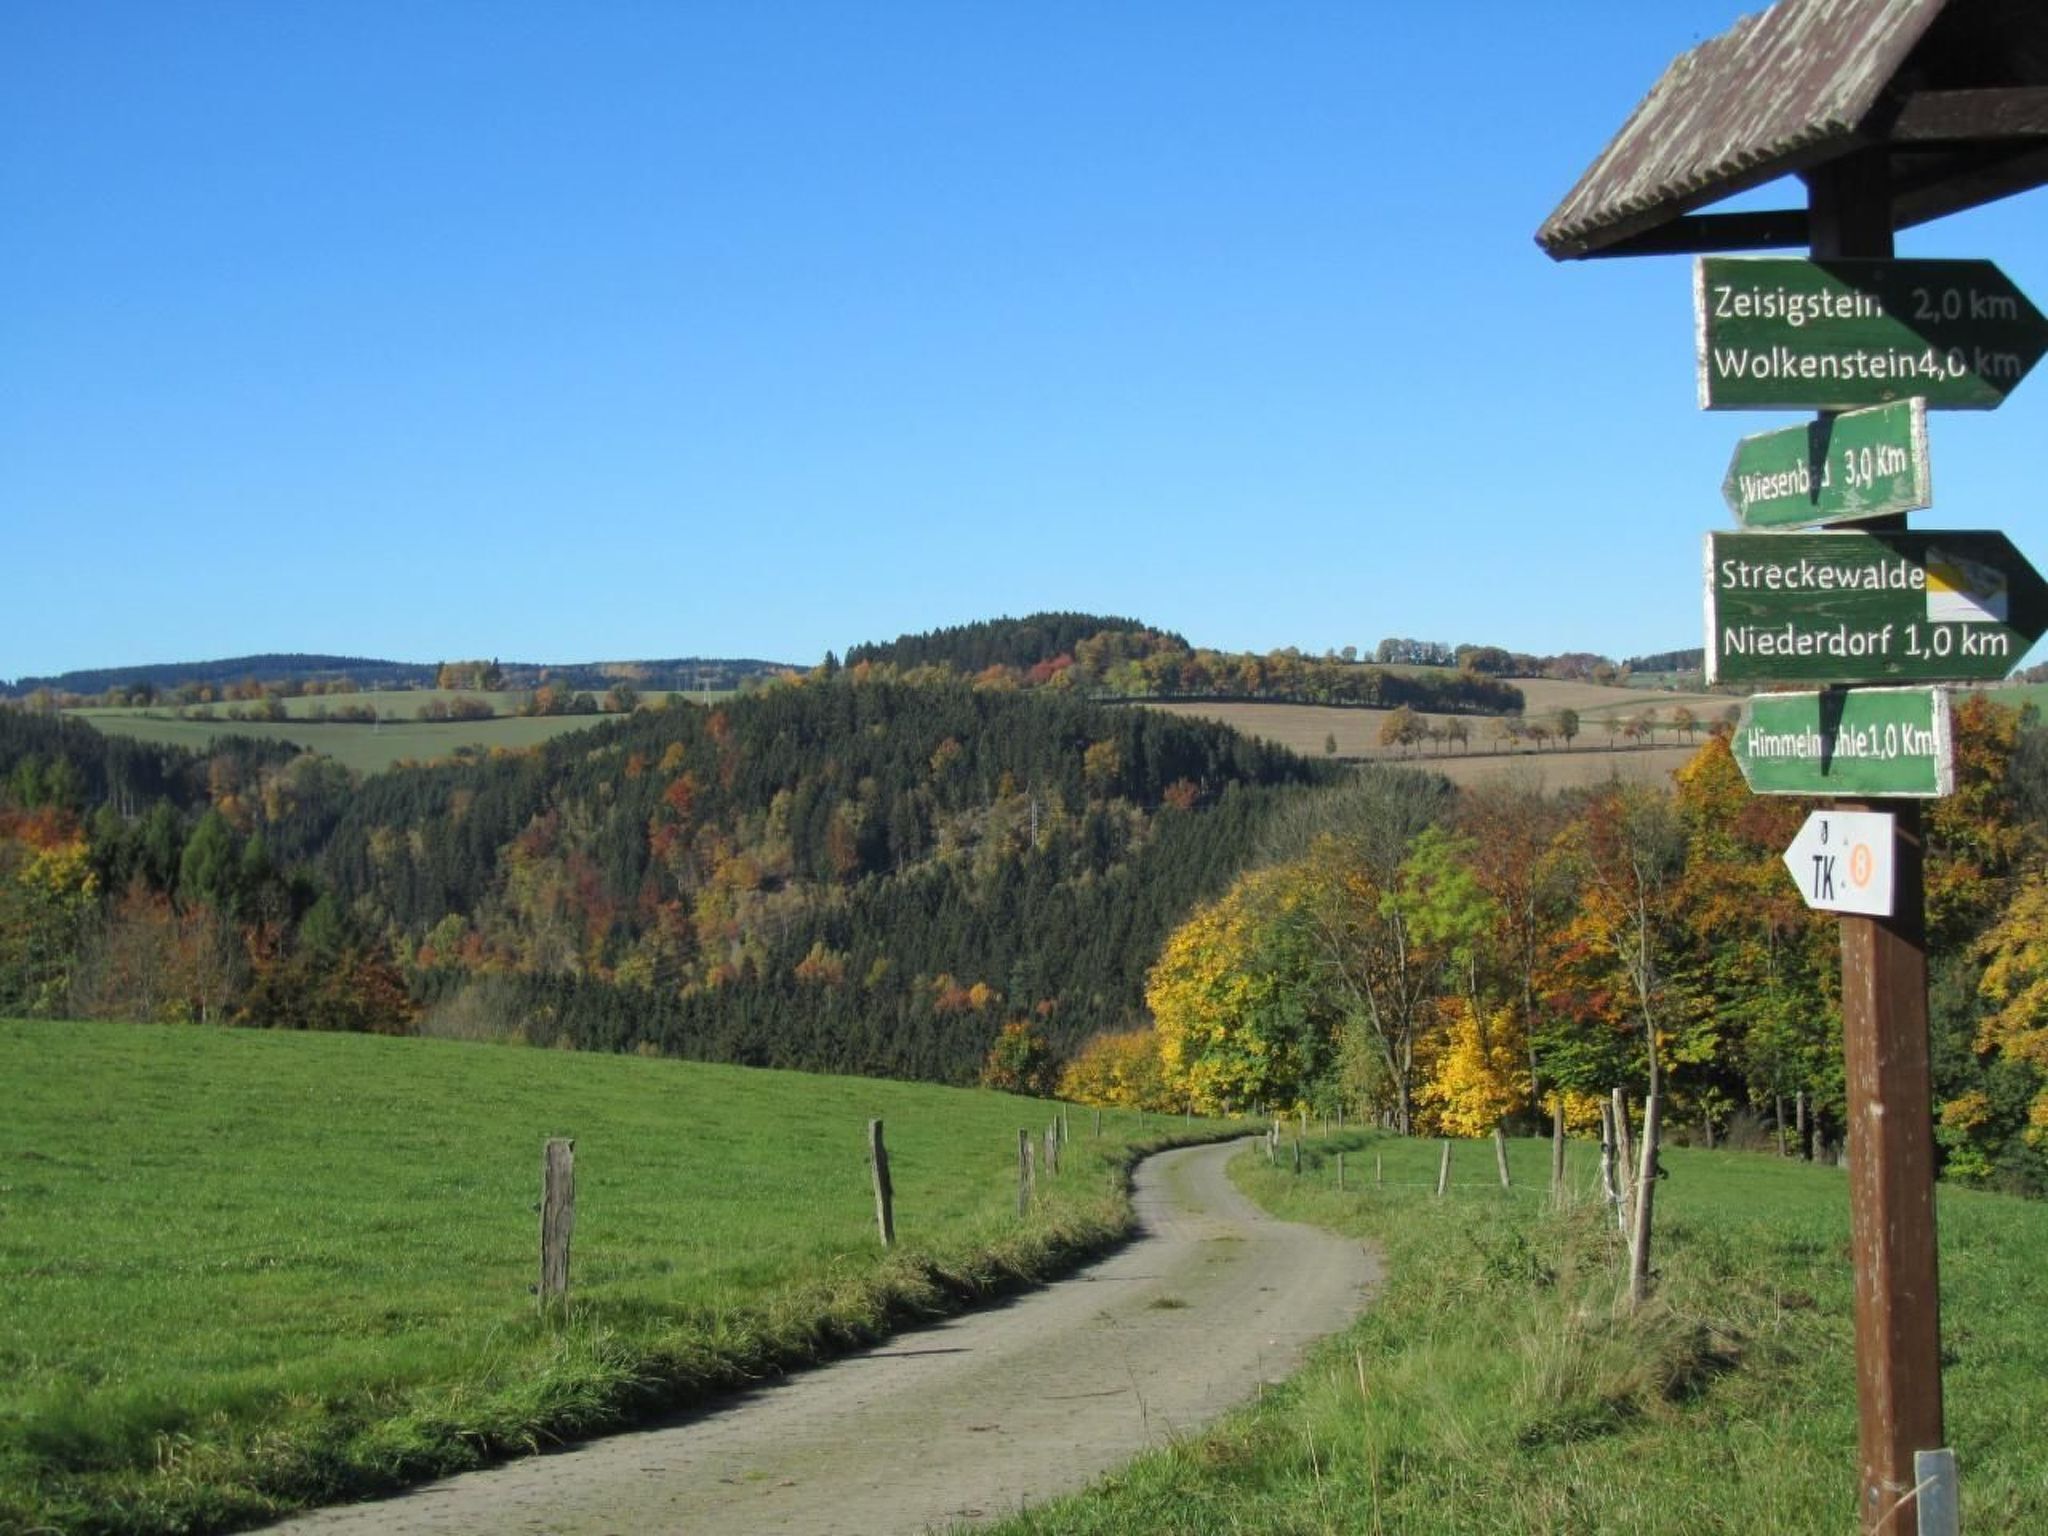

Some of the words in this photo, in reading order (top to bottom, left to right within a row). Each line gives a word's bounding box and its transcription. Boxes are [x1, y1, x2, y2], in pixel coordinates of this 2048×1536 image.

[1713, 286, 1883, 326] Zeisigstein
[1912, 287, 1962, 324] 2,0
[1970, 288, 2018, 320] km
[1714, 346, 1916, 379] Wolkenstein
[1918, 346, 1966, 381] 4,0
[1975, 346, 2022, 378] km
[1739, 457, 1831, 503] Wiesenbd
[1721, 559, 1925, 590] Streckewalde
[1724, 622, 1893, 657] Niederdorf
[1904, 623, 1952, 660] 1,0
[1963, 623, 2009, 657] km
[1812, 855, 1835, 900] TK
